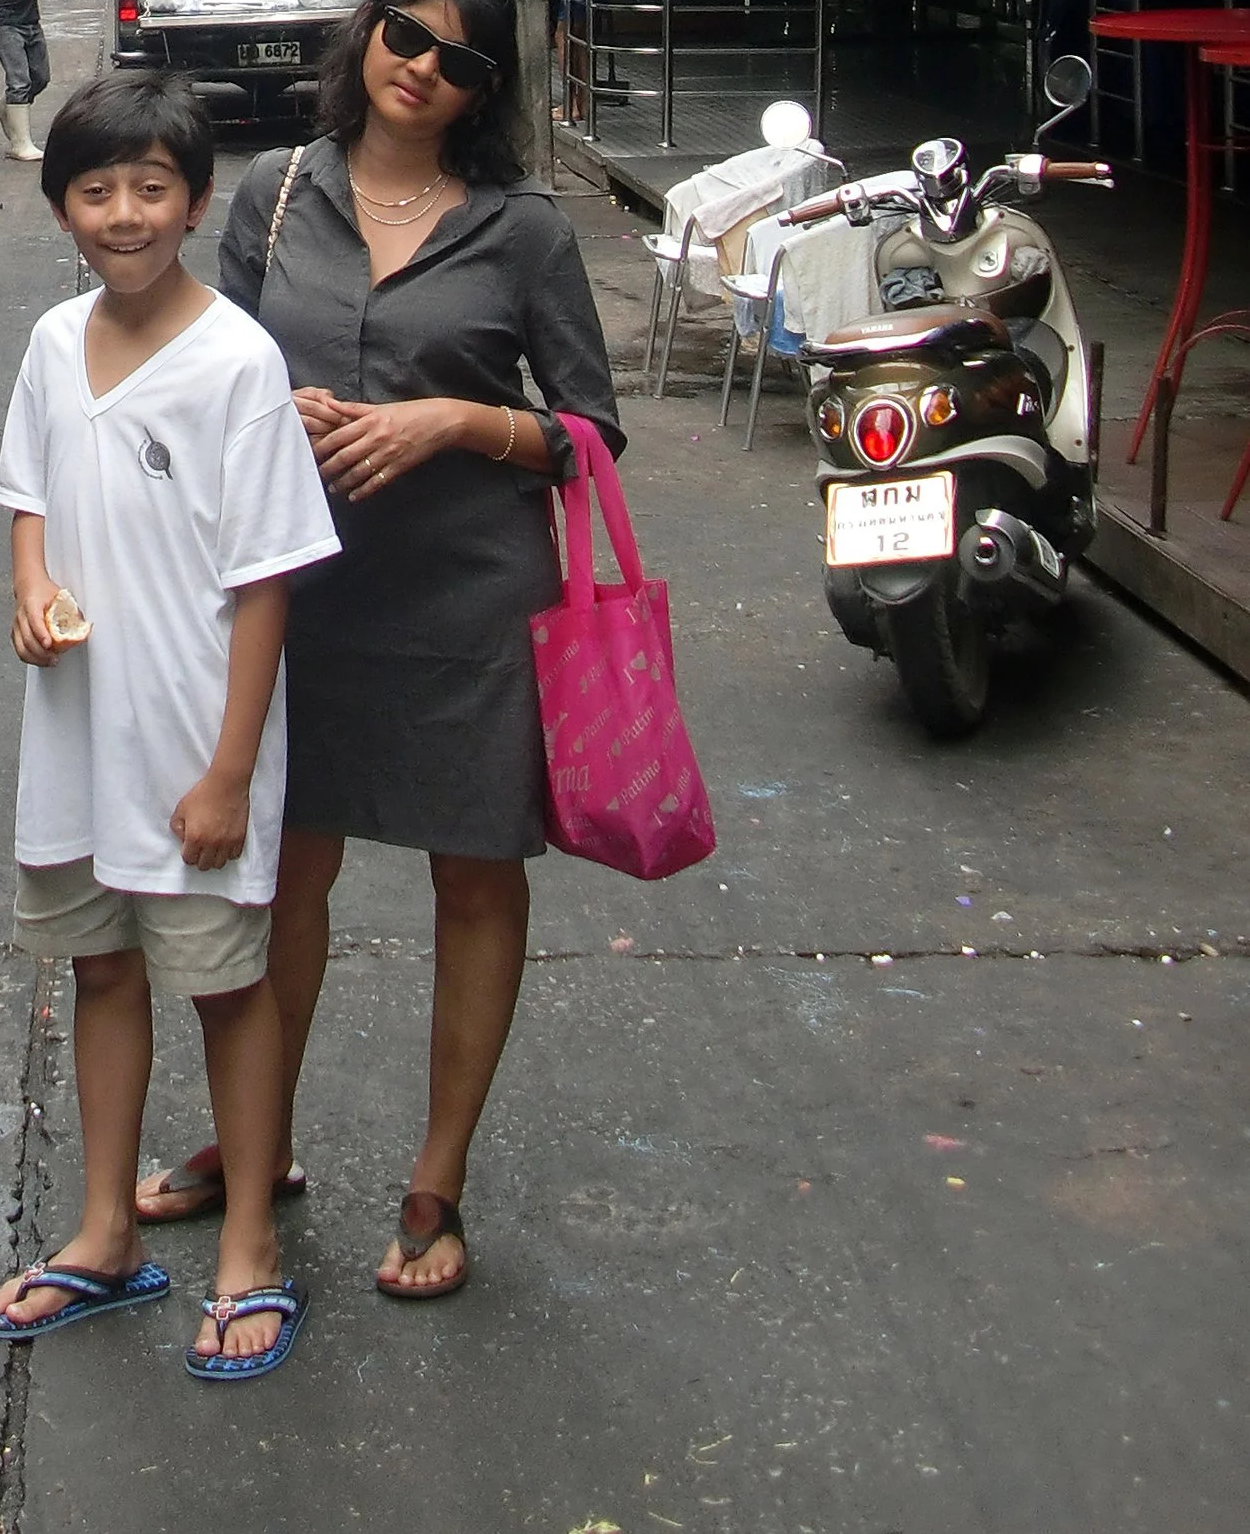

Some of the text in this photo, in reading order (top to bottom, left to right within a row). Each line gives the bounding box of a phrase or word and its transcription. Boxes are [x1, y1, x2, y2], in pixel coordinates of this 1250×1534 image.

[265, 43, 299, 59] 6872
[860, 323, 894, 335] YAMAHA
[877, 532, 910, 552] 12
